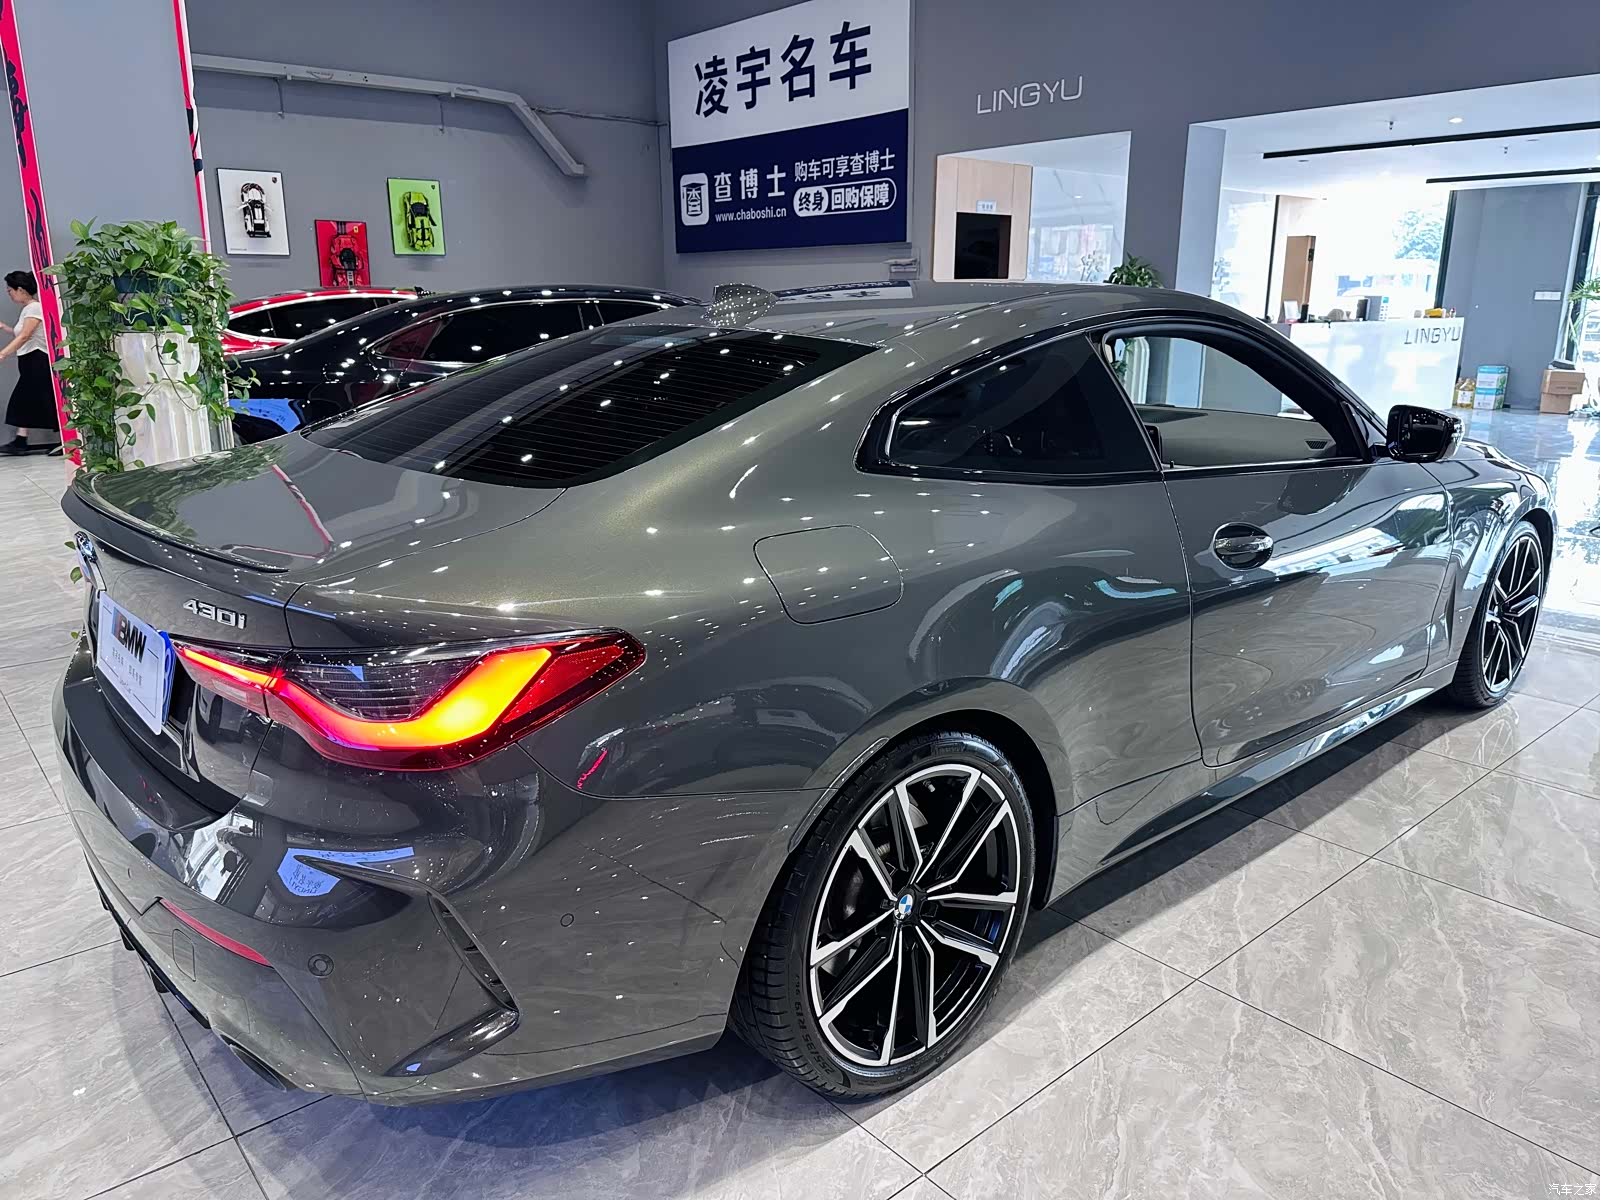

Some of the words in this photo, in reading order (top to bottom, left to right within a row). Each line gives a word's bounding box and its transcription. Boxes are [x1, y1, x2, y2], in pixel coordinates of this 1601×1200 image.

[694, 21, 872, 118] 凌宇名车
[977, 76, 1083, 114] LINGYU
[795, 148, 895, 182] 购车可享查博士
[714, 165, 786, 202] 查博士
[798, 189, 825, 212] 终身
[831, 183, 889, 210] 回购保障
[715, 207, 787, 222] www.chaboshi.cn
[1404, 326, 1461, 345] LINGYU
[183, 598, 246, 629] 430i
[117, 612, 147, 663] BMW
